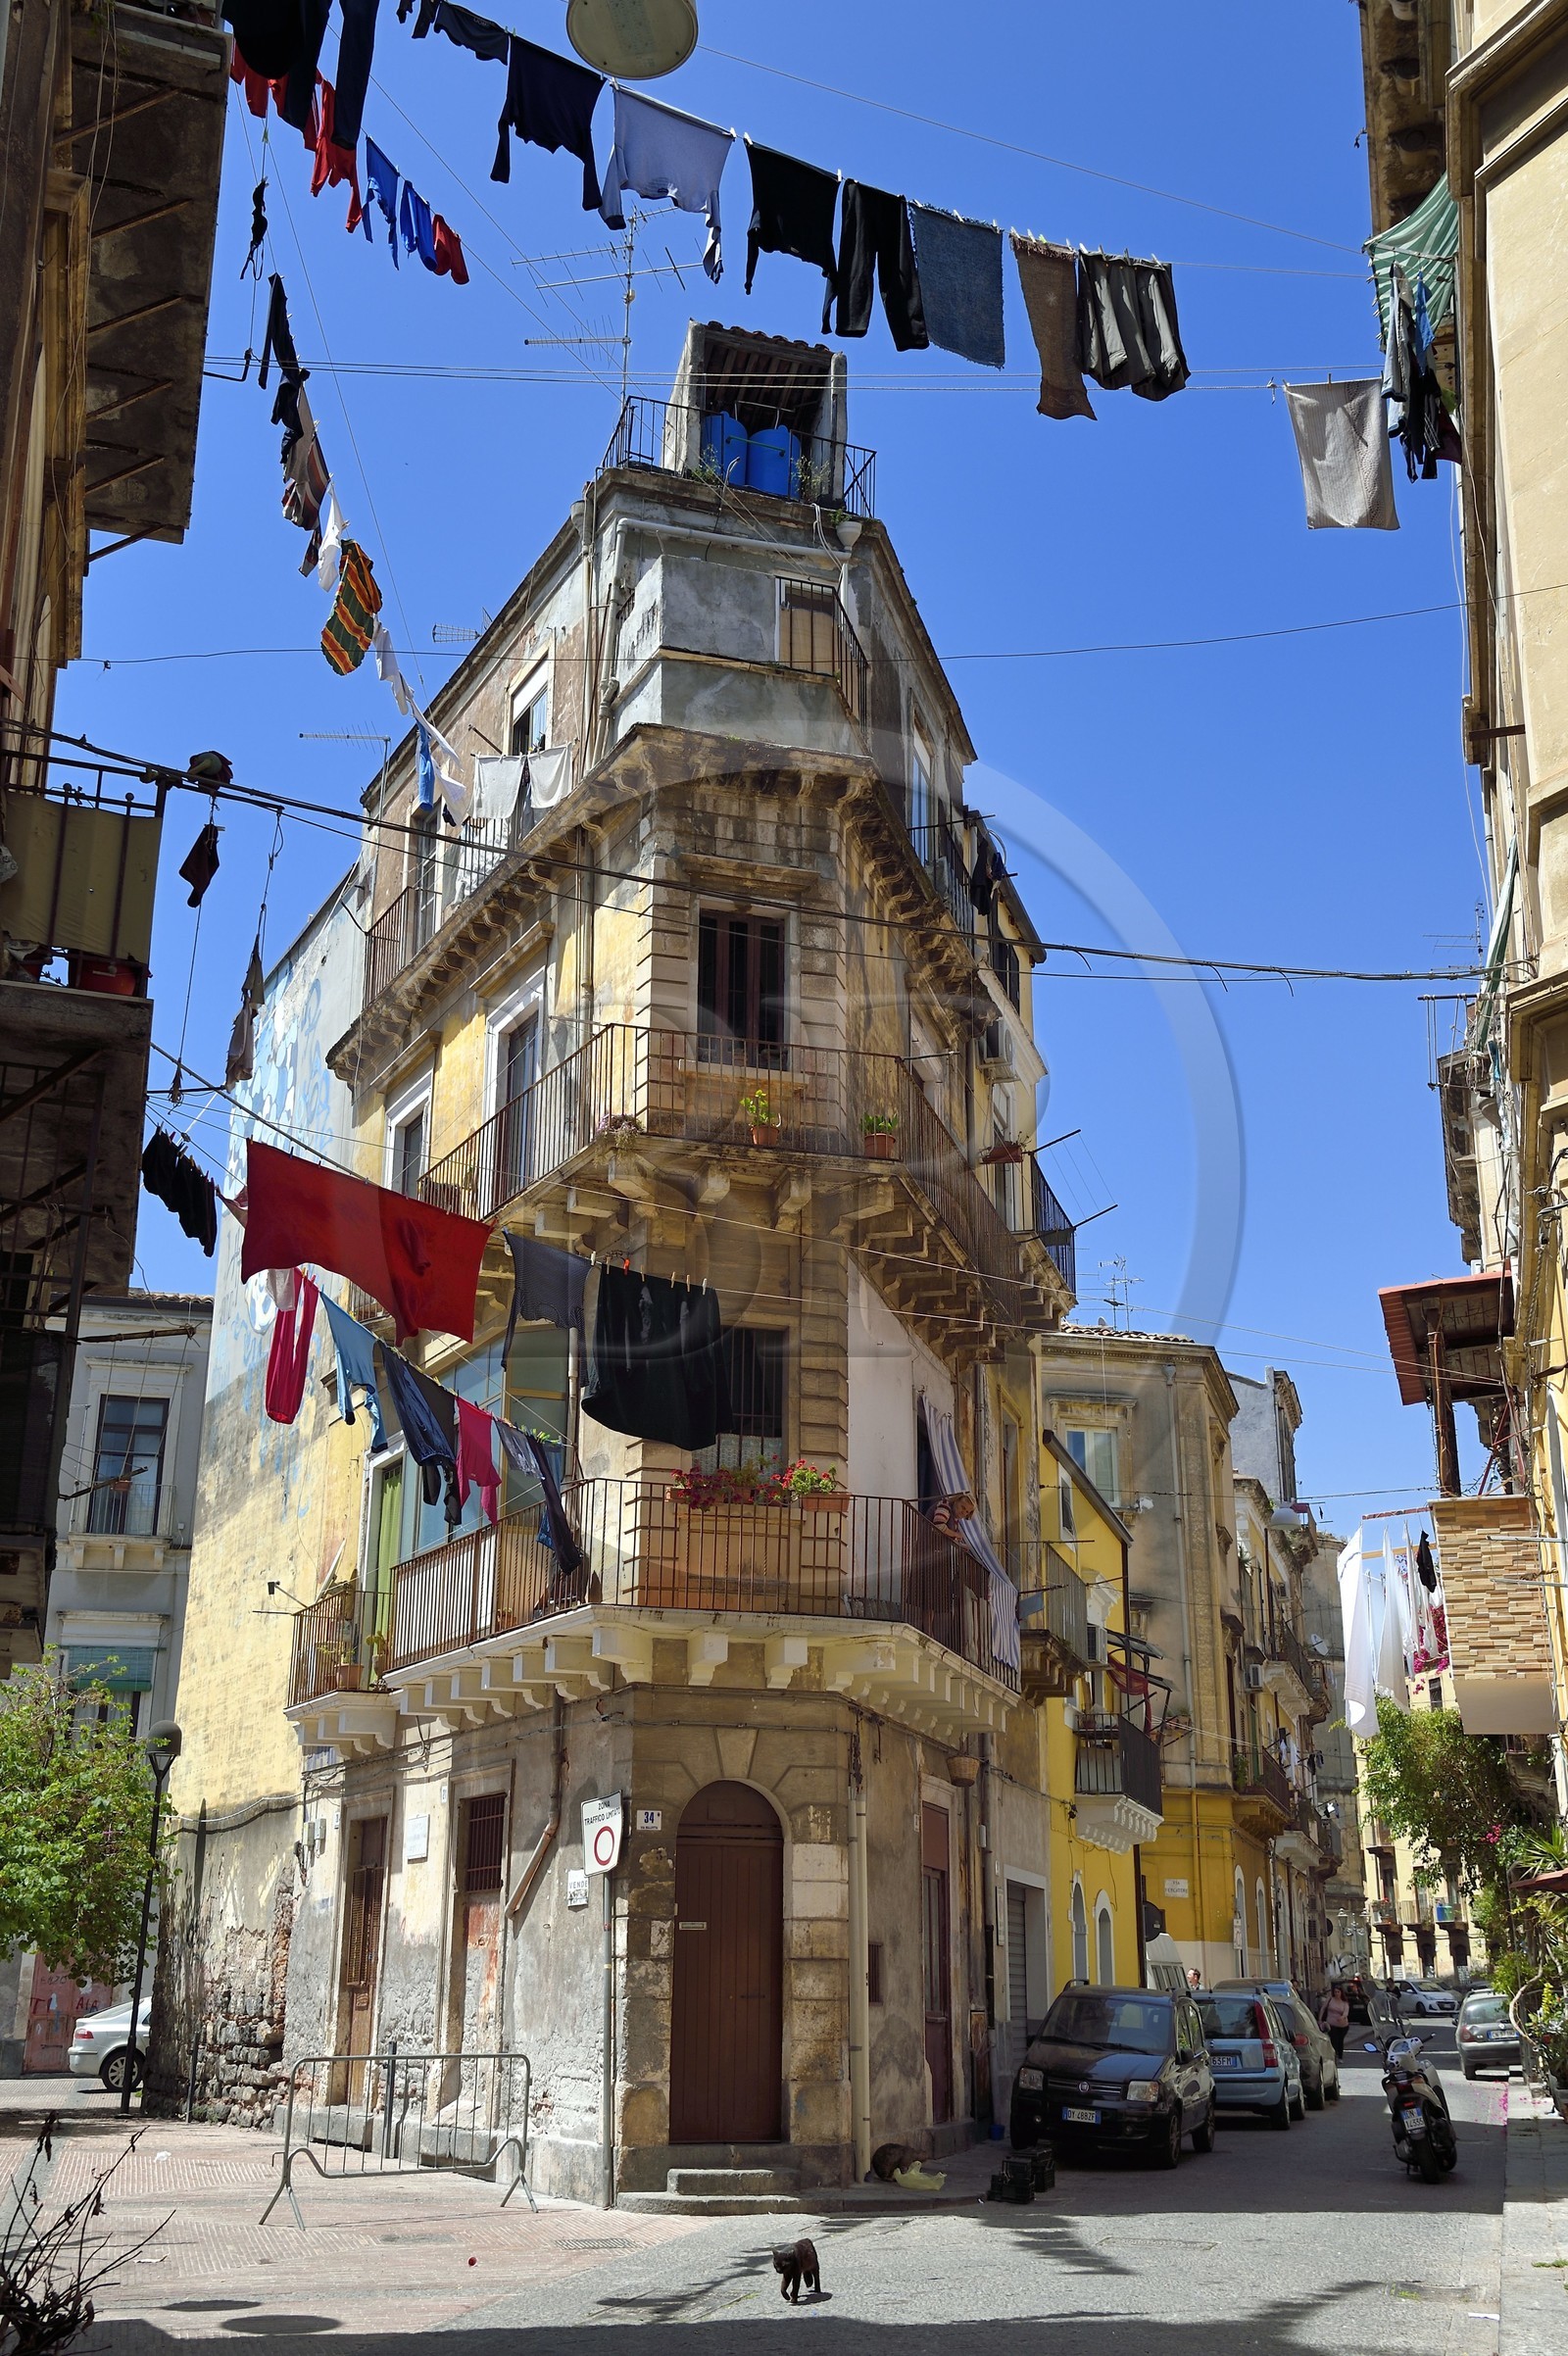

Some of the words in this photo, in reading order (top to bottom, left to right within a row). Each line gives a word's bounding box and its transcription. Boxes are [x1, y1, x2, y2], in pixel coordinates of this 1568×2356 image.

[598, 1800, 611, 1811] ZONA
[584, 1813, 606, 1826] TRAFFICO
[644, 1811, 654, 1824] 34
[1210, 2056, 1232, 2067] 63FM
